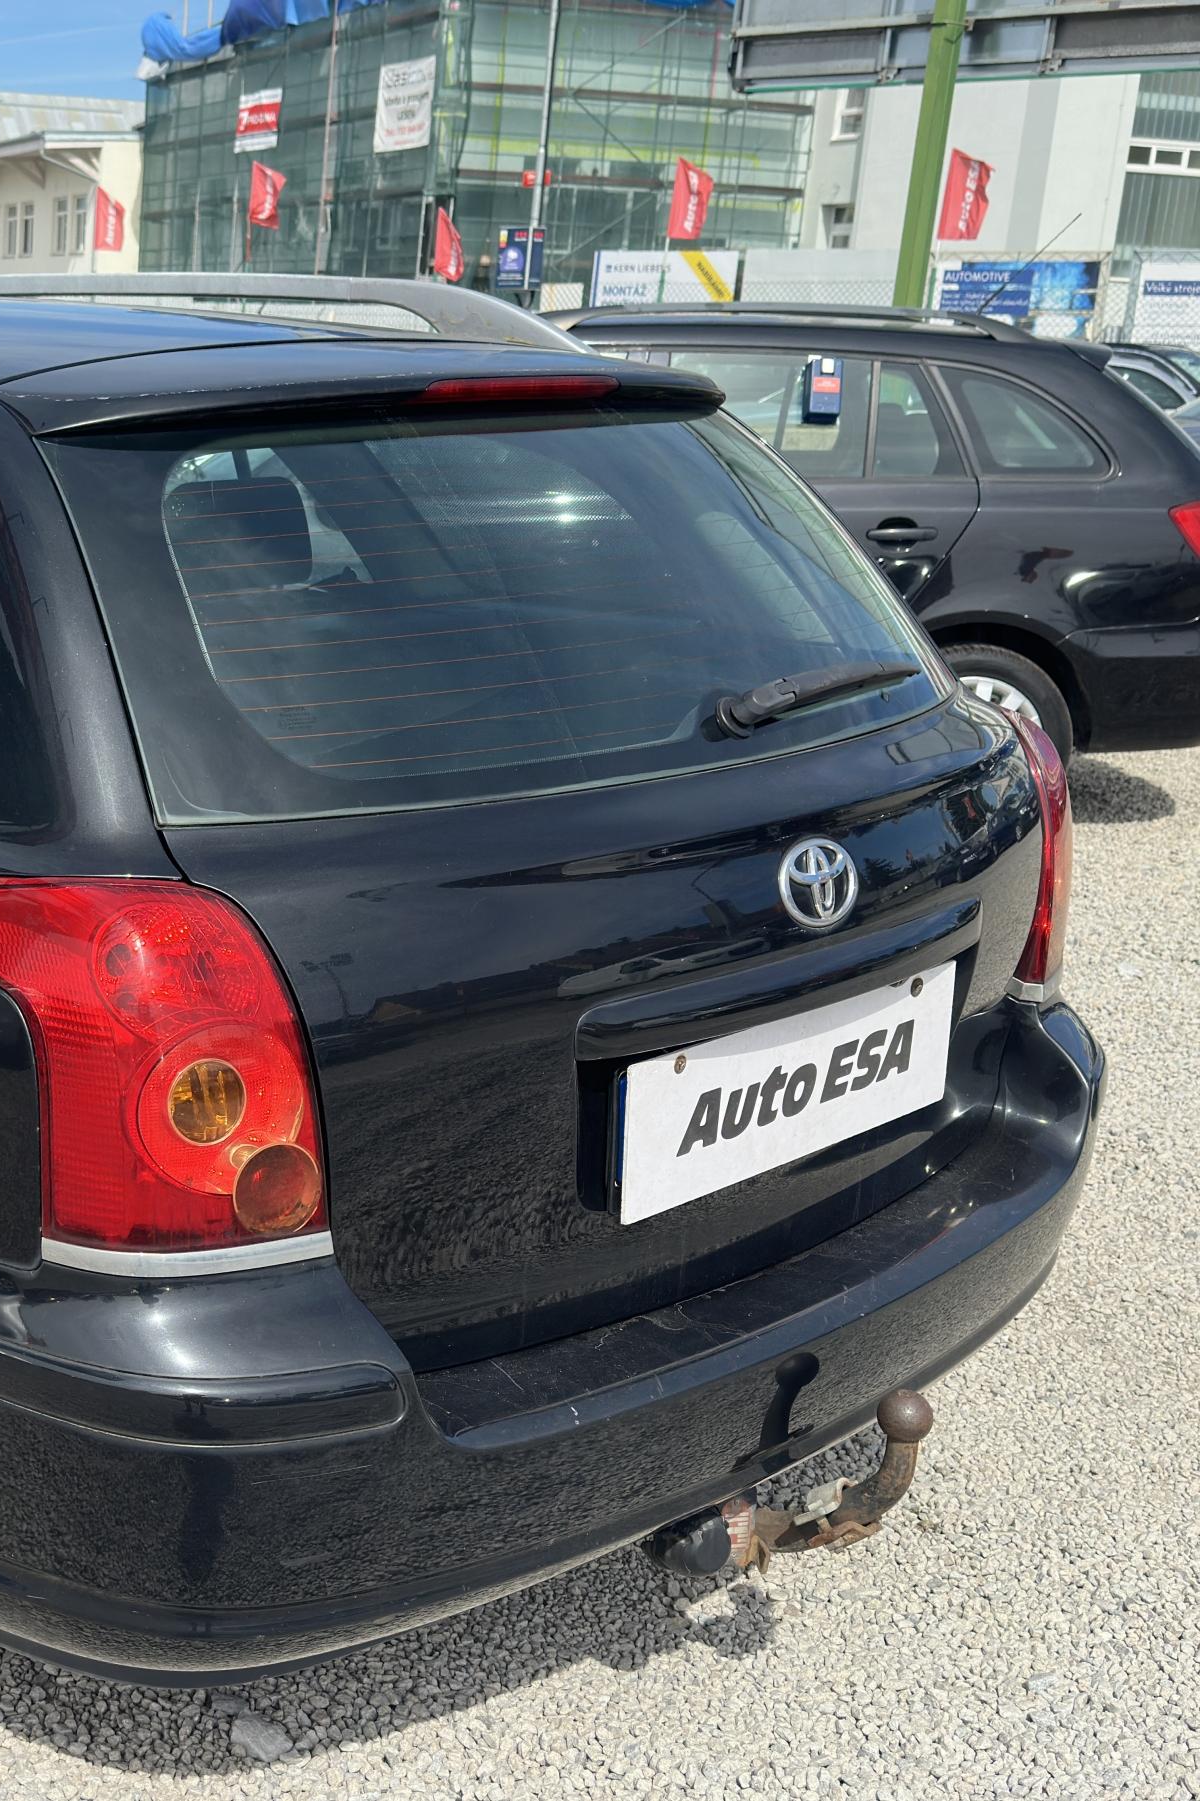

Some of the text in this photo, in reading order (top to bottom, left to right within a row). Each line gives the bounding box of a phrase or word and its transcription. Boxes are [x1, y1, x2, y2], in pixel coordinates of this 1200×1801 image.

[944, 271, 1011, 283] AUTOMOTIVE
[602, 284, 647, 297] MONTÁŽ
[675, 1018, 916, 1158] Auto ESA
